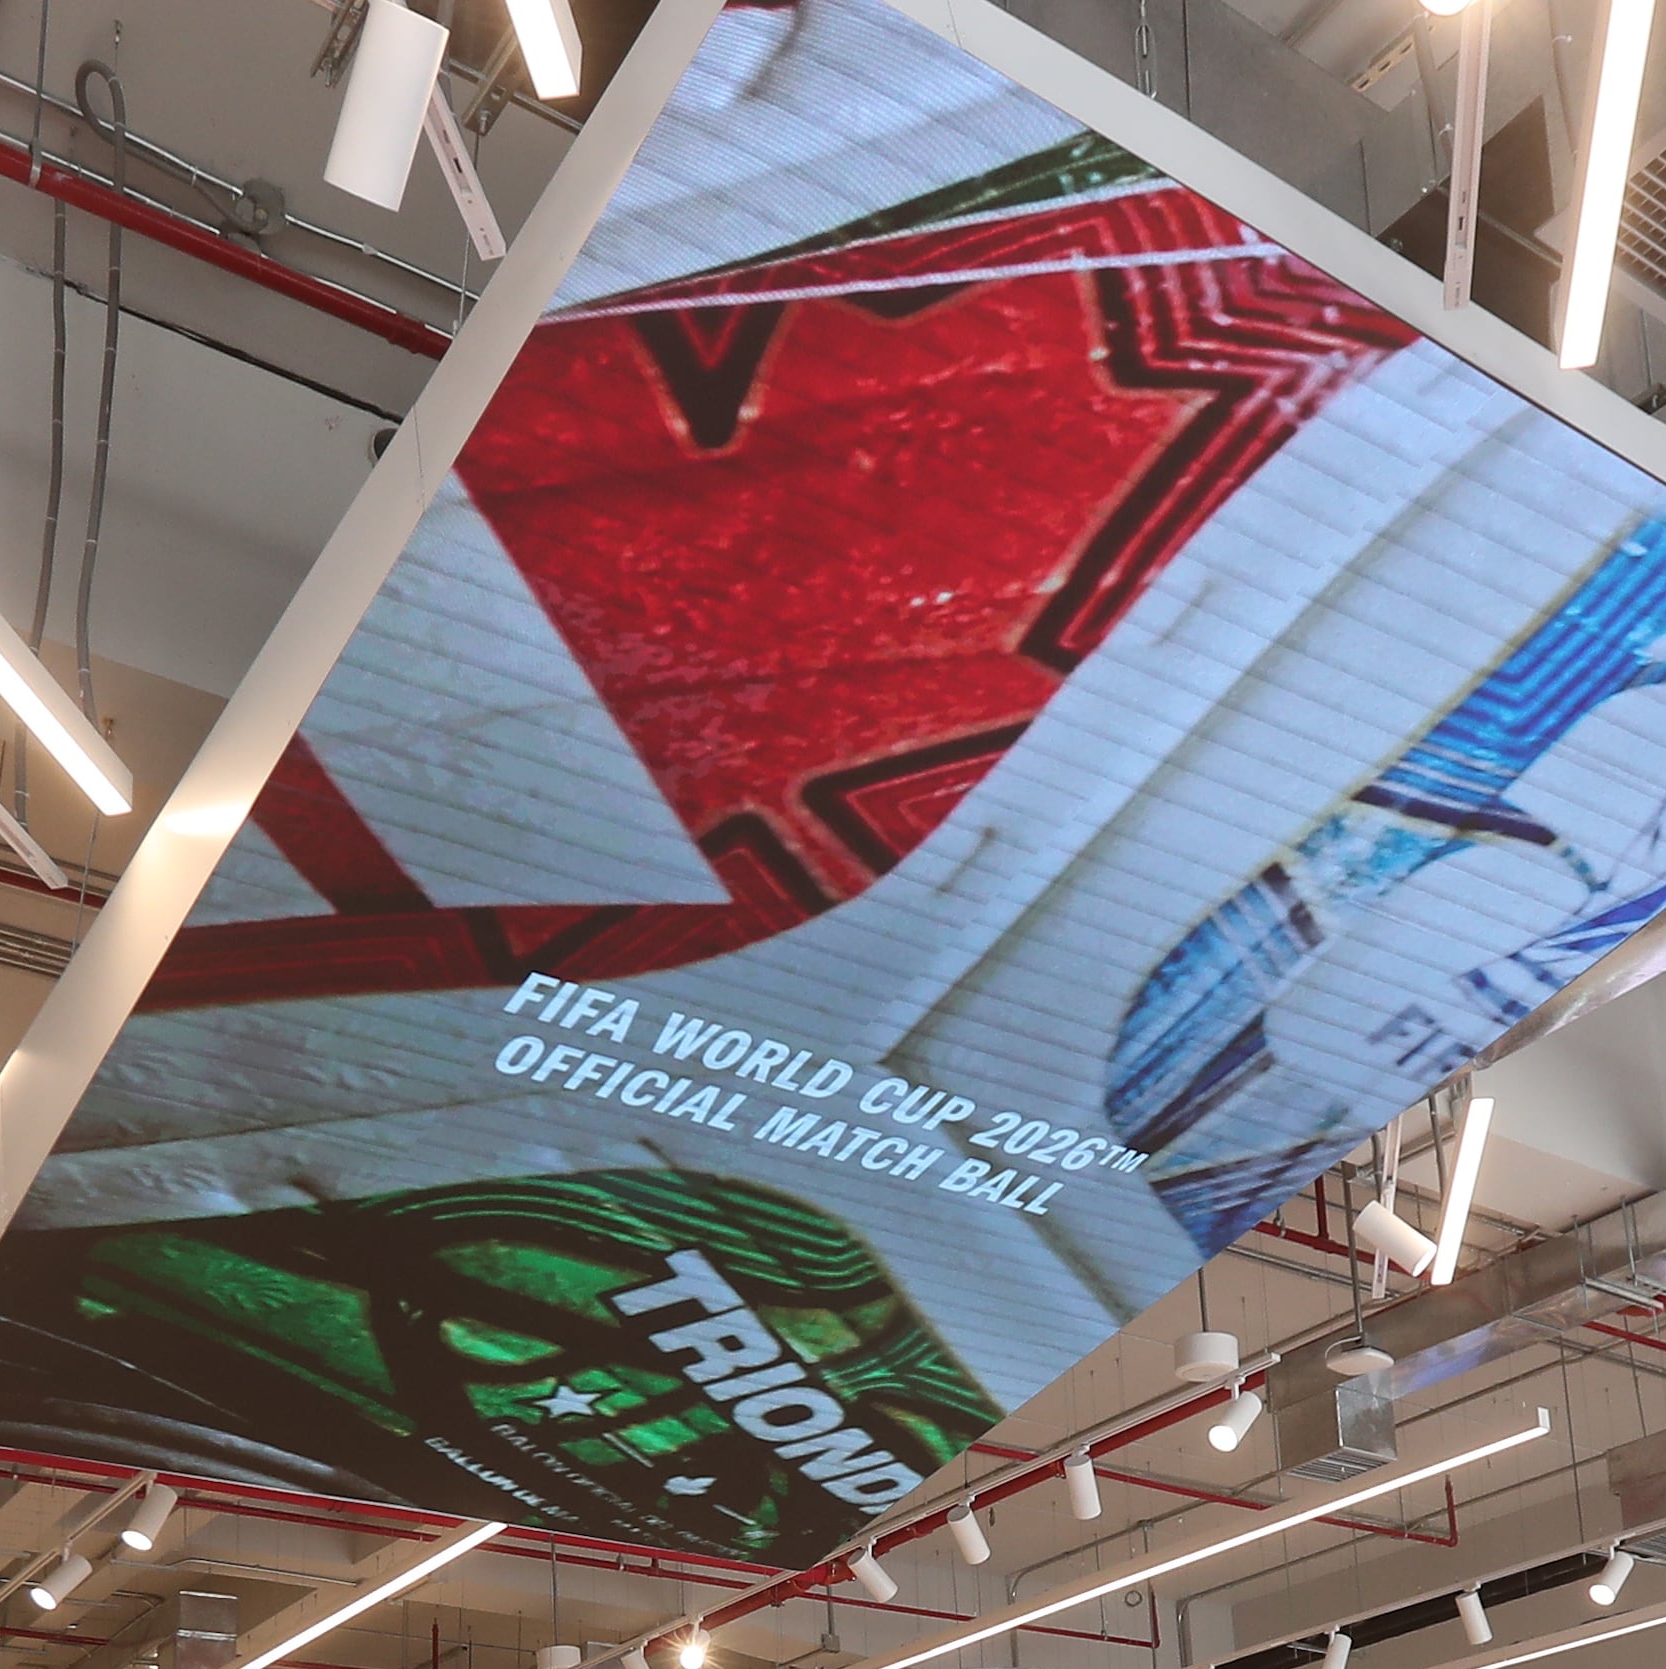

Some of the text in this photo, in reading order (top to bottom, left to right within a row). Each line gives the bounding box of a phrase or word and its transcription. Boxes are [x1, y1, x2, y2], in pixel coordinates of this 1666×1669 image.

[494, 1035, 1067, 1216] OFFICIAL MATCH BALL
[503, 971, 640, 1043] FIFA
[652, 1011, 853, 1099] WORLD
[858, 1077, 975, 1132] CUP
[611, 1249, 925, 1515] TRIOND
